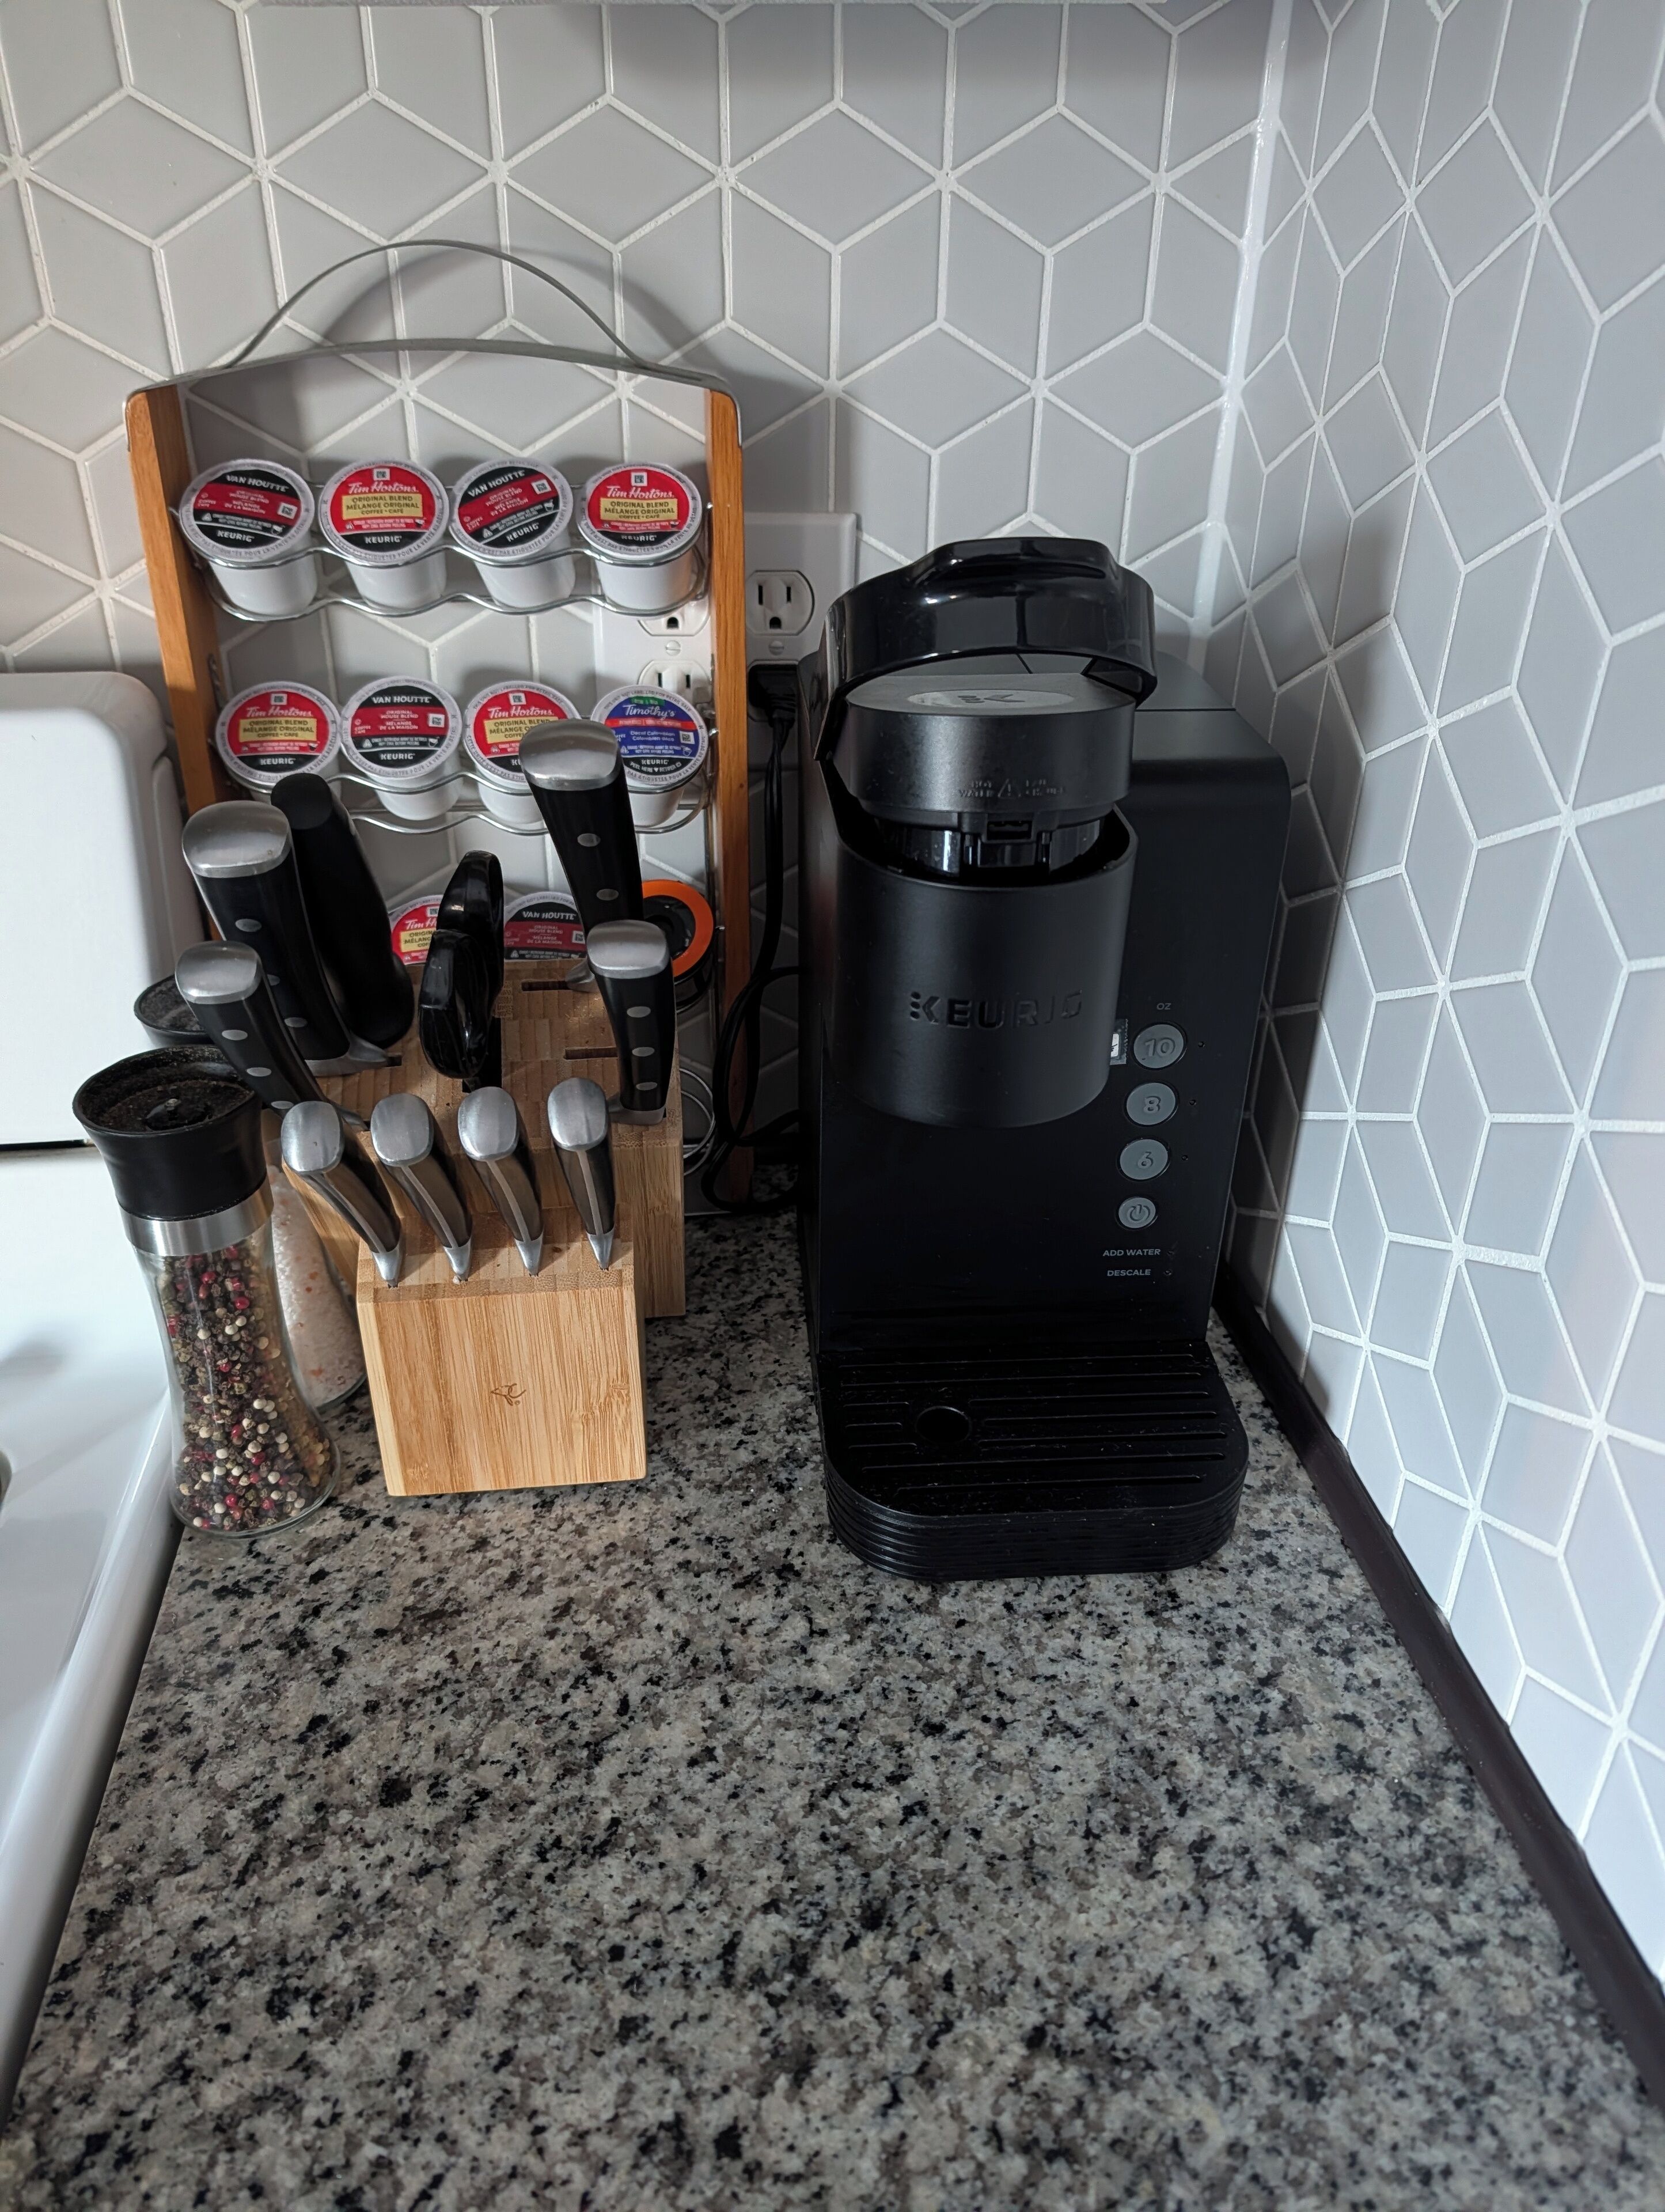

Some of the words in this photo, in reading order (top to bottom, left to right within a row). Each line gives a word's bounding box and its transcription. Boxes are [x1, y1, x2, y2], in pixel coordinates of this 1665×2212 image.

[226, 475, 246, 483] VAN
[248, 478, 287, 492] HOUTTE
[348, 482, 369, 494] Tim
[371, 481, 417, 493] Hortons
[468, 484, 488, 497] VAN
[491, 470, 525, 488] HOUTTE
[606, 486, 627, 497] Tim
[629, 487, 673, 498] Hortons
[352, 495, 386, 503] ORIGINAL
[346, 502, 381, 510] MÉLANGE
[604, 506, 639, 514] MÉLANGE
[217, 530, 252, 542] KEURIG
[506, 524, 539, 542] KEURIG
[365, 536, 401, 544] KEURIG
[246, 706, 266, 717] Tim
[488, 707, 509, 718] Tim
[510, 706, 552, 717] Hortons
[623, 704, 675, 720] Timothy's
[490, 726, 524, 734] MÉLANGE
[542, 912, 575, 920] HOUTTE
[404, 918, 424, 930] Tim
[910, 990, 1083, 1029] KEURIG
[1156, 1002, 1171, 1010] OZ
[1144, 1037, 1176, 1058] 10
[1143, 1096, 1161, 1115] 8
[1137, 1151, 1154, 1170] 6
[1127, 1248, 1161, 1256] WATER
